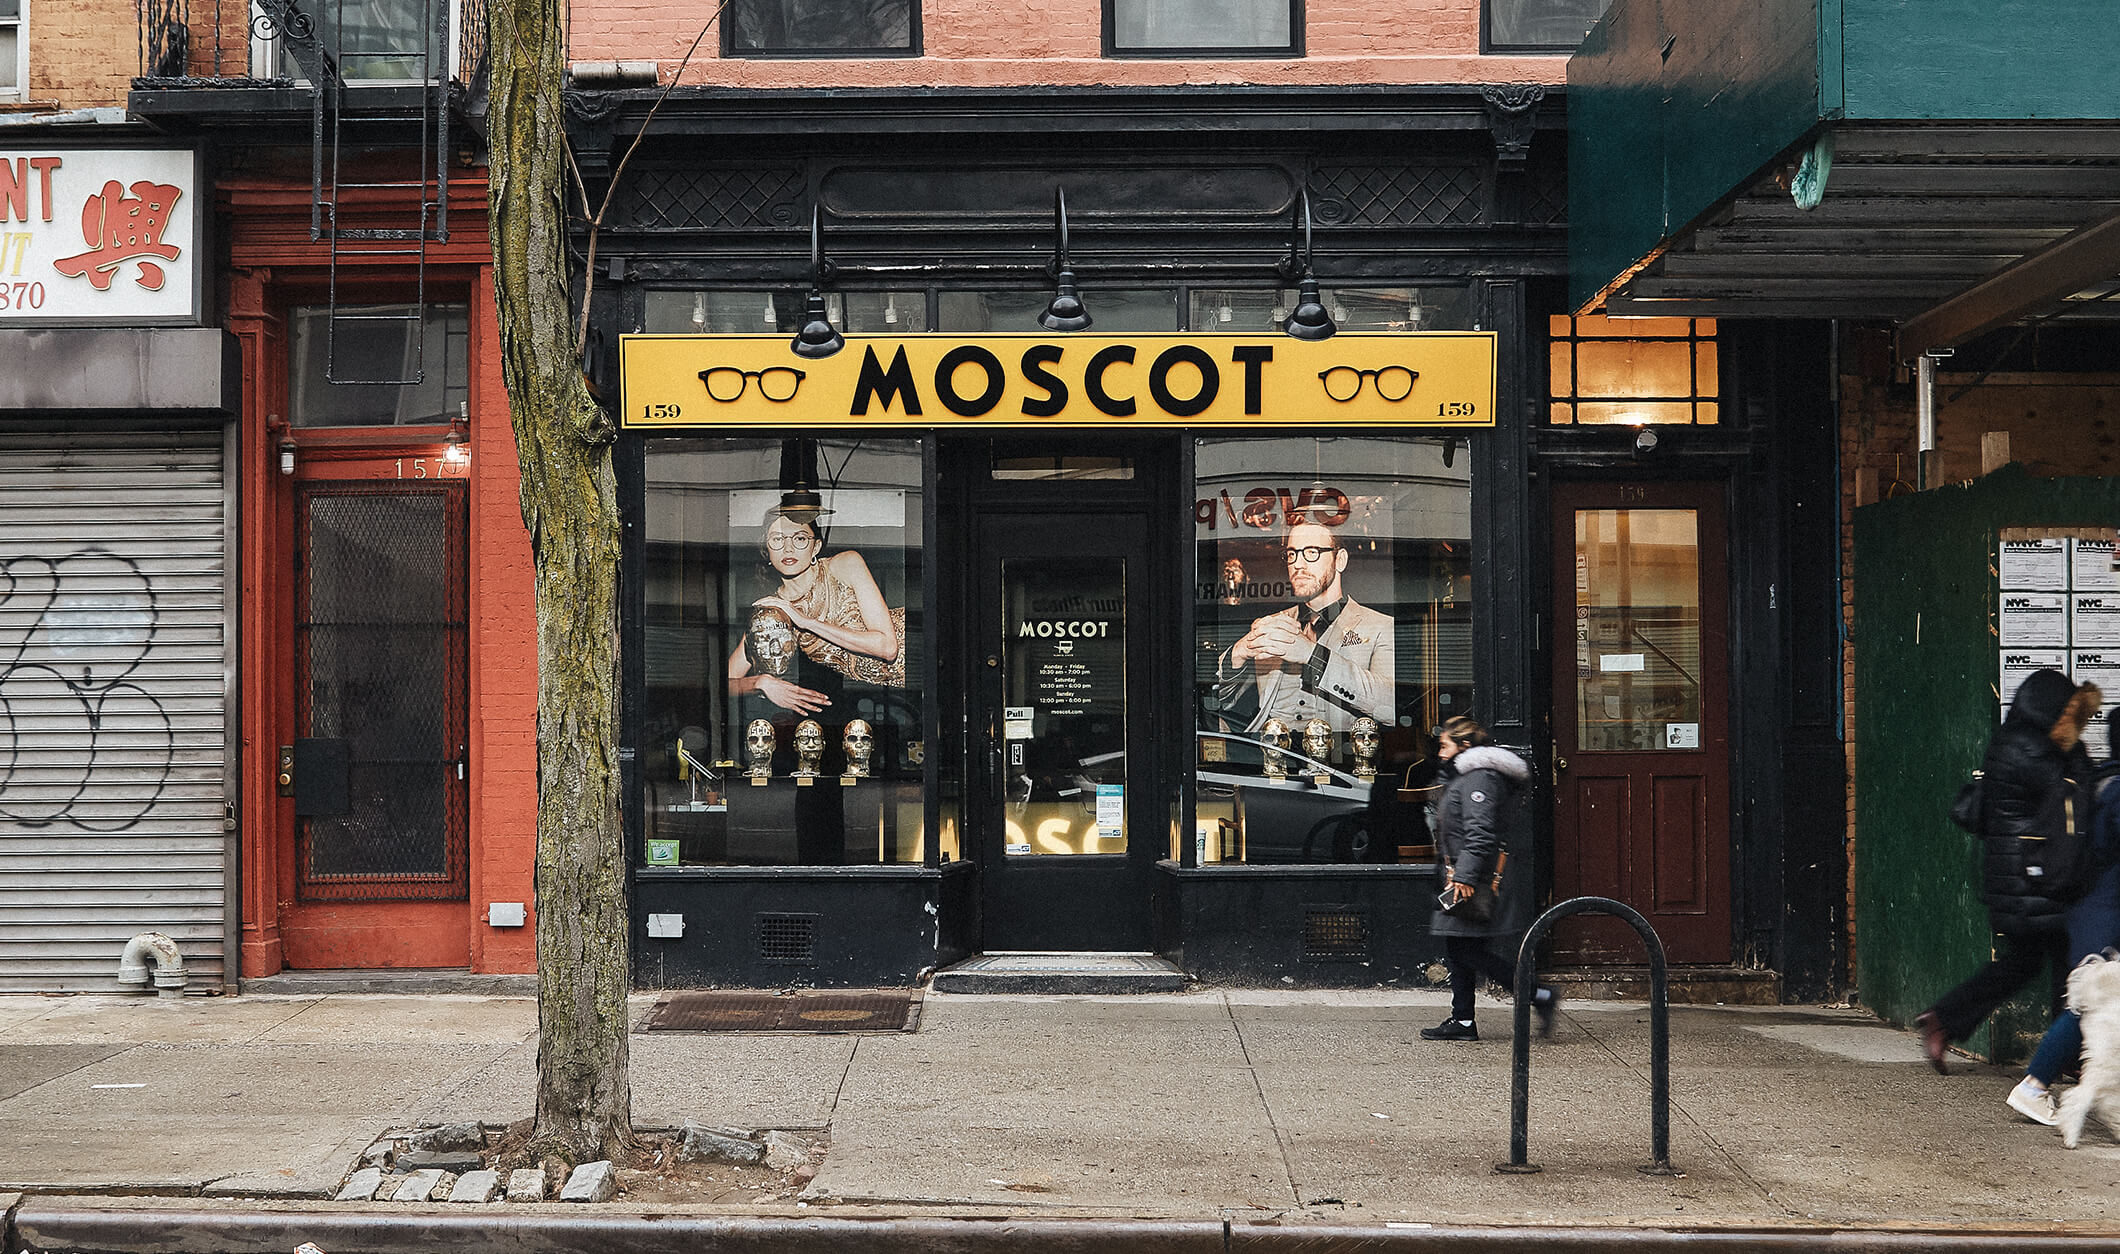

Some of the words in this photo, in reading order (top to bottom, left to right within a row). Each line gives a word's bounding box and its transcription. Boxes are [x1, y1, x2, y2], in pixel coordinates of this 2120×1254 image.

[0, 157, 62, 222] NT
[849, 343, 1274, 417] MOSCOT
[643, 404, 682, 418] 159
[1437, 402, 1476, 416] 159
[395, 458, 446, 479] 157
[2006, 599, 2030, 608] NYC
[2078, 599, 2102, 608] NYC
[1019, 621, 1108, 637] MOSCOT
[2006, 656, 2030, 664] NYC
[2078, 655, 2102, 663] NYC
[1006, 710, 1024, 718] Pull
